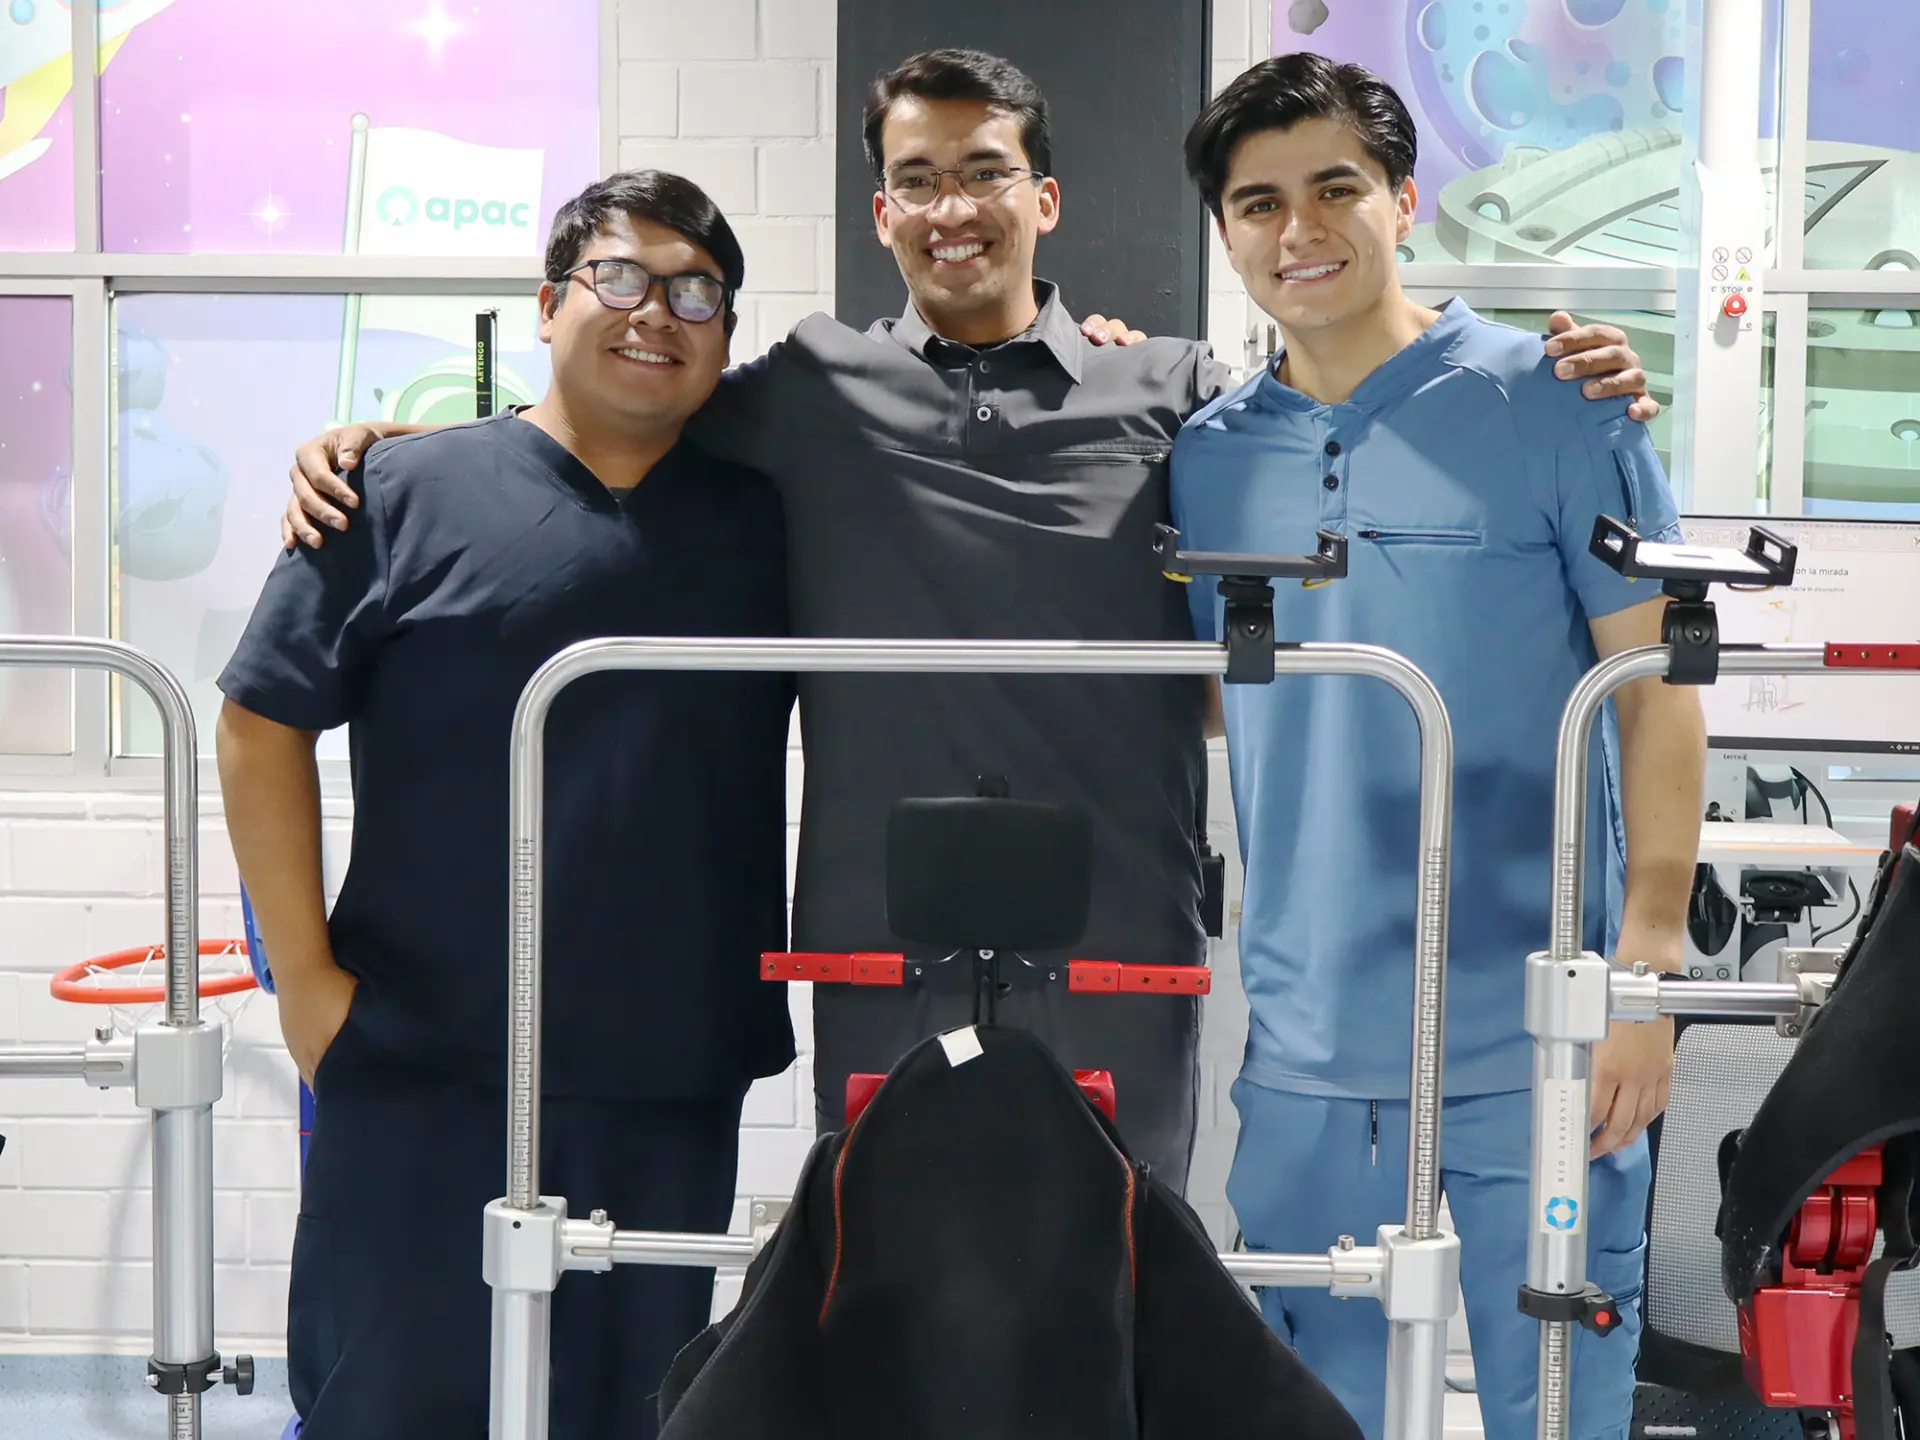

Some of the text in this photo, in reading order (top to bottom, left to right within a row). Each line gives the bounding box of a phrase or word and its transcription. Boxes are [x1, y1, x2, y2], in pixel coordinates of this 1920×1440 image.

[425, 197, 530, 230] apac
[1722, 286, 1743, 294] STOP
[477, 341, 485, 384] ARTENGO
[1809, 567, 1816, 575] la
[1819, 567, 1849, 576] mirada
[1557, 1160, 1565, 1183] RÍO
